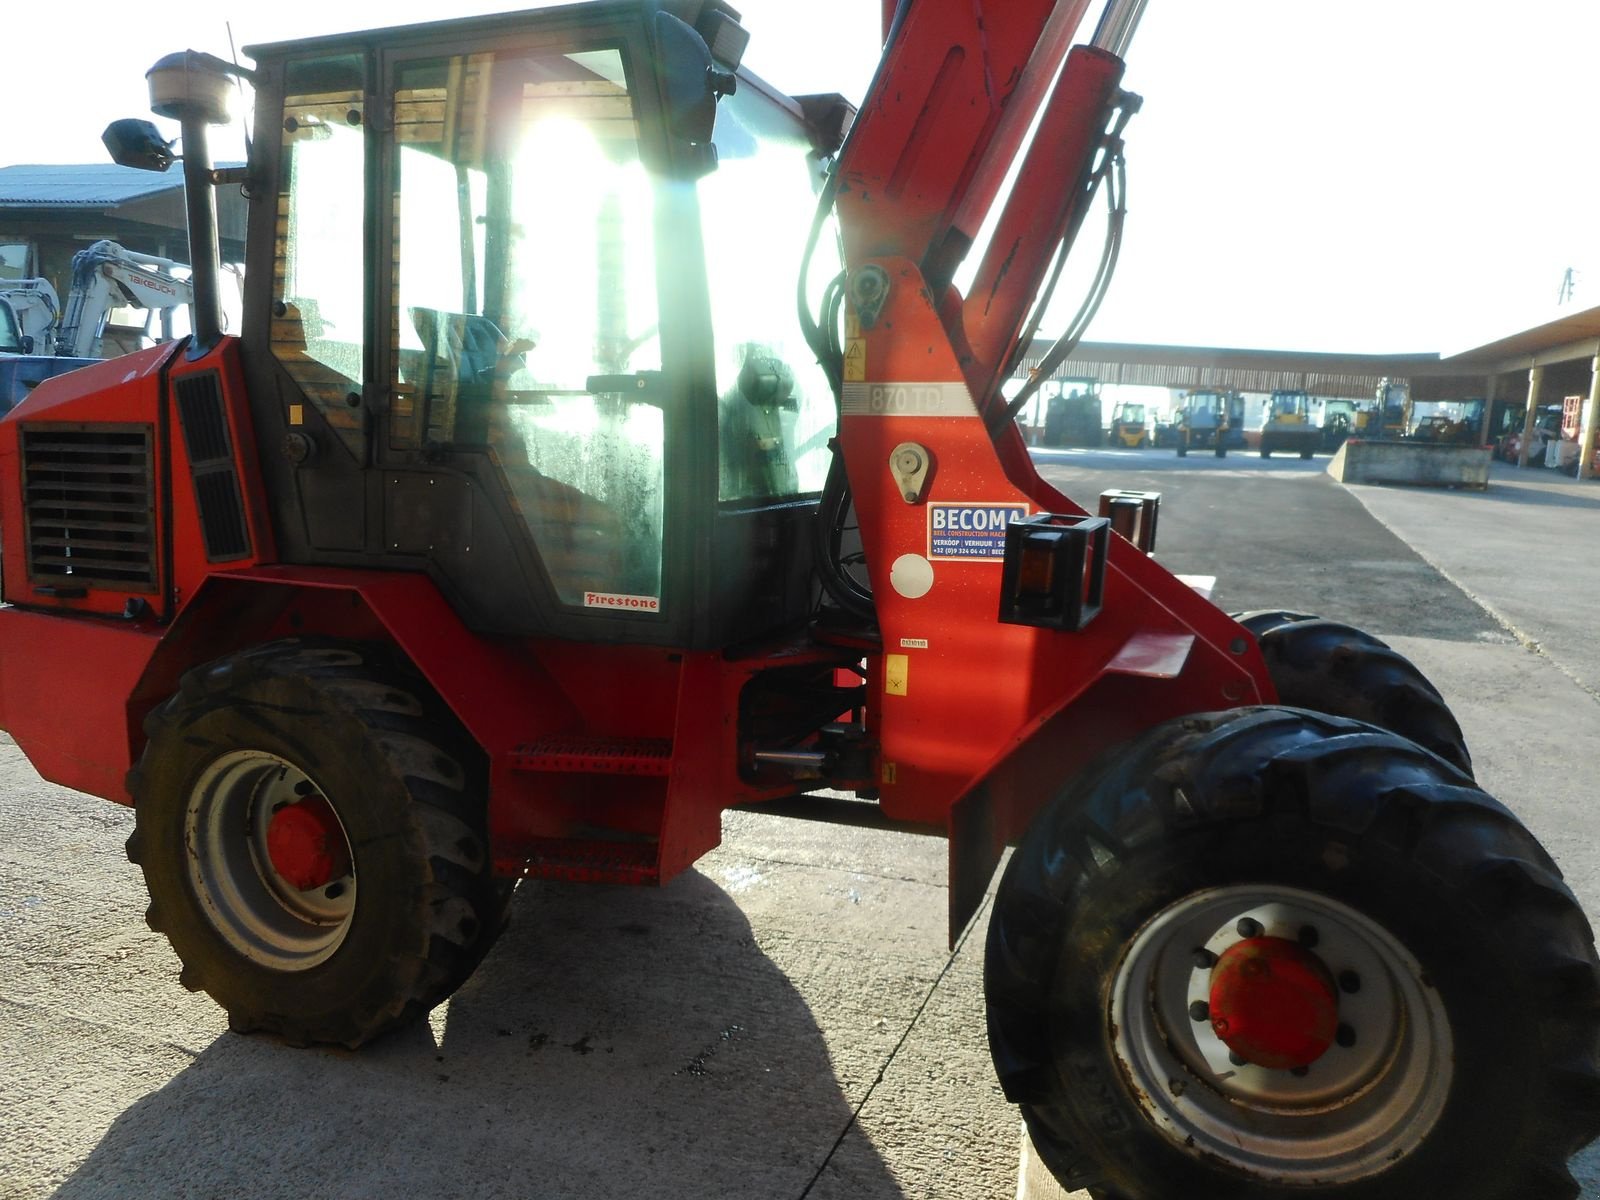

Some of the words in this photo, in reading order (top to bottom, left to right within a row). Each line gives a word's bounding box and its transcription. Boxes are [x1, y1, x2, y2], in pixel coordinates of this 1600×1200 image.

[871, 387, 906, 410] 870
[933, 509, 1020, 530] BECOMA
[965, 540, 993, 548] VERHUUR
[587, 593, 657, 609] Firestone
